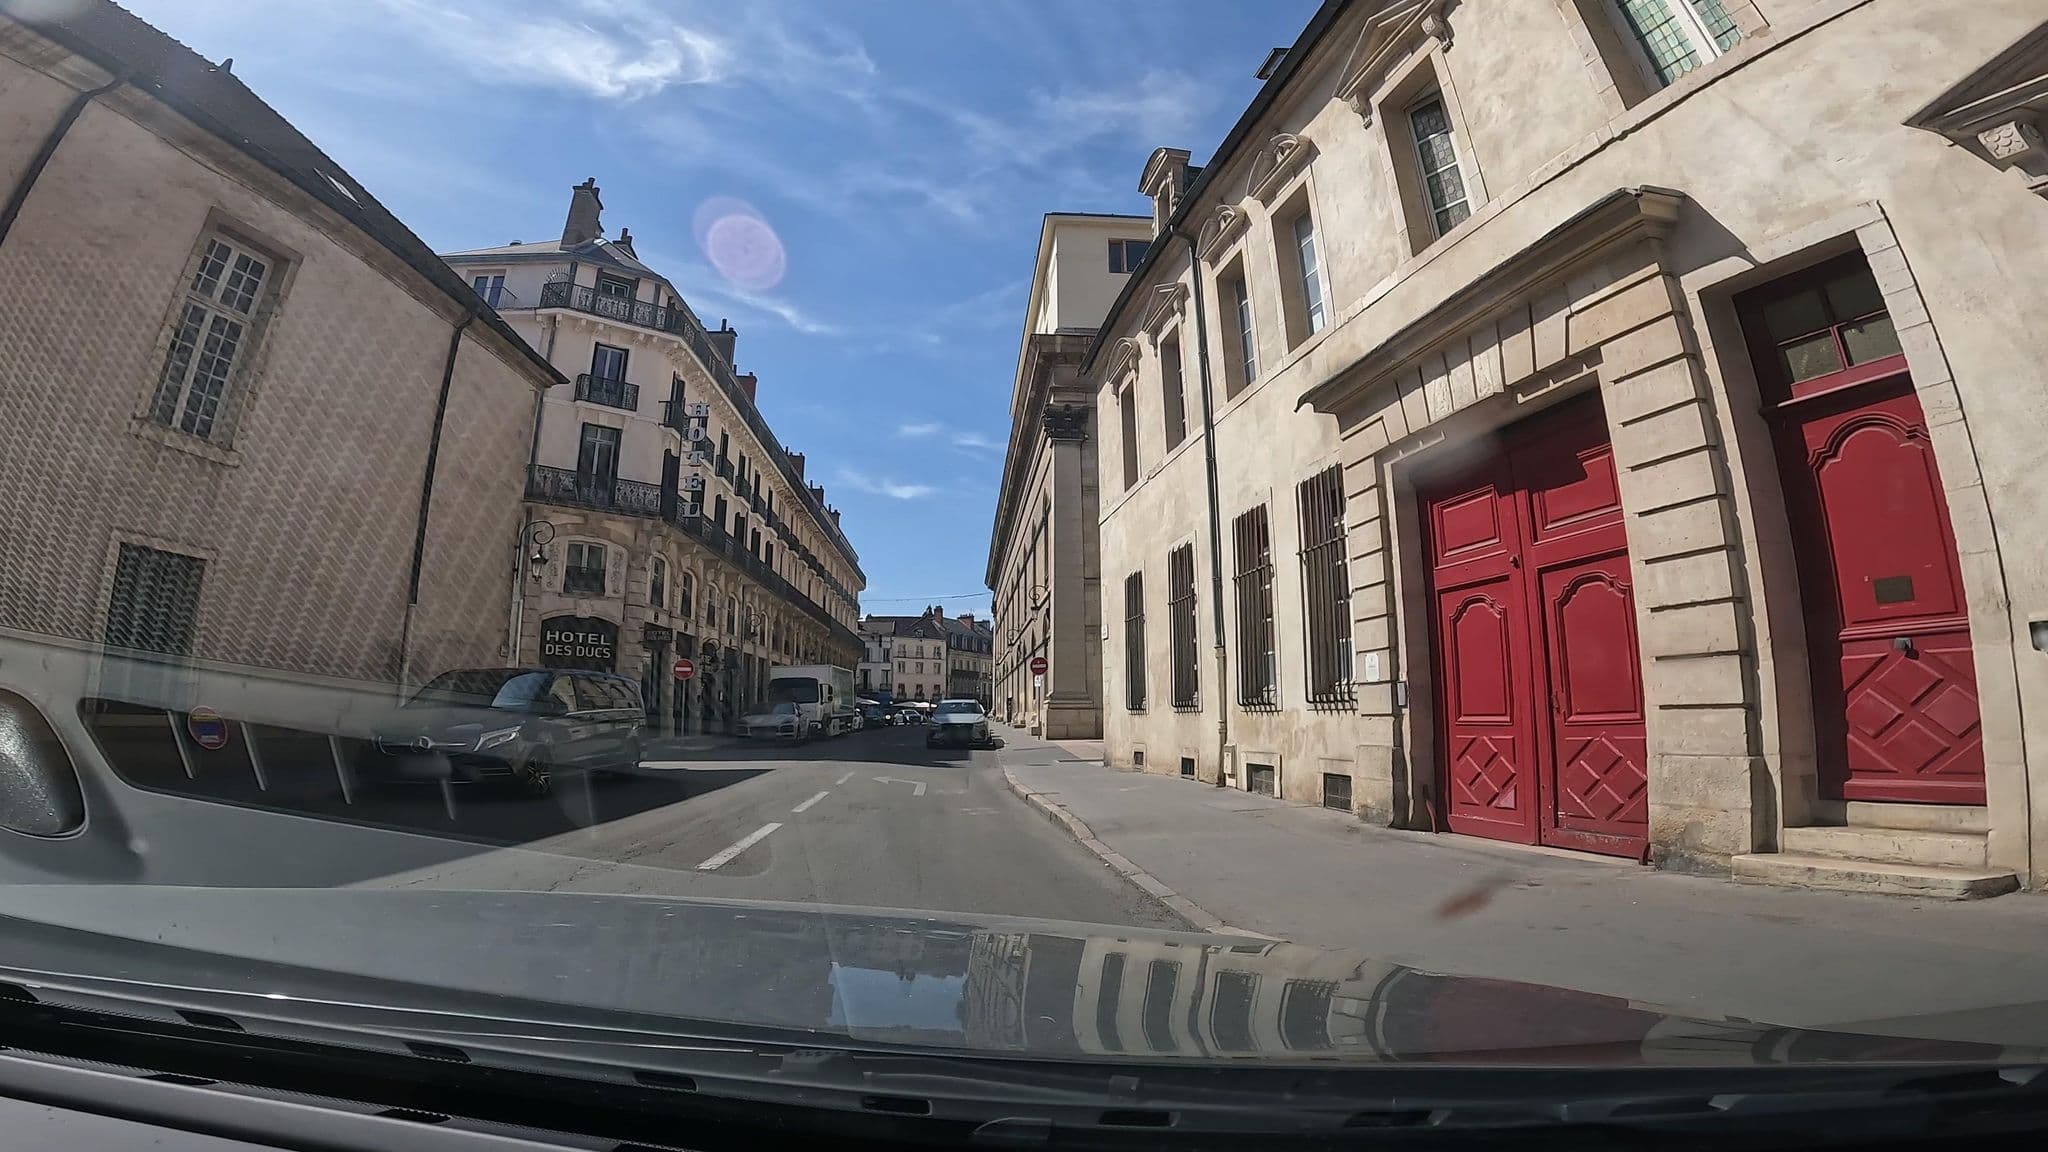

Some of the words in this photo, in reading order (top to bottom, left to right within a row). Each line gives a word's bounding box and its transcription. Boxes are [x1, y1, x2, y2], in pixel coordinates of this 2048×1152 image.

[683, 402, 710, 518] HOTEL
[546, 630, 611, 646] HOTEL
[545, 643, 572, 656] DES
[576, 645, 611, 659] DUCS
